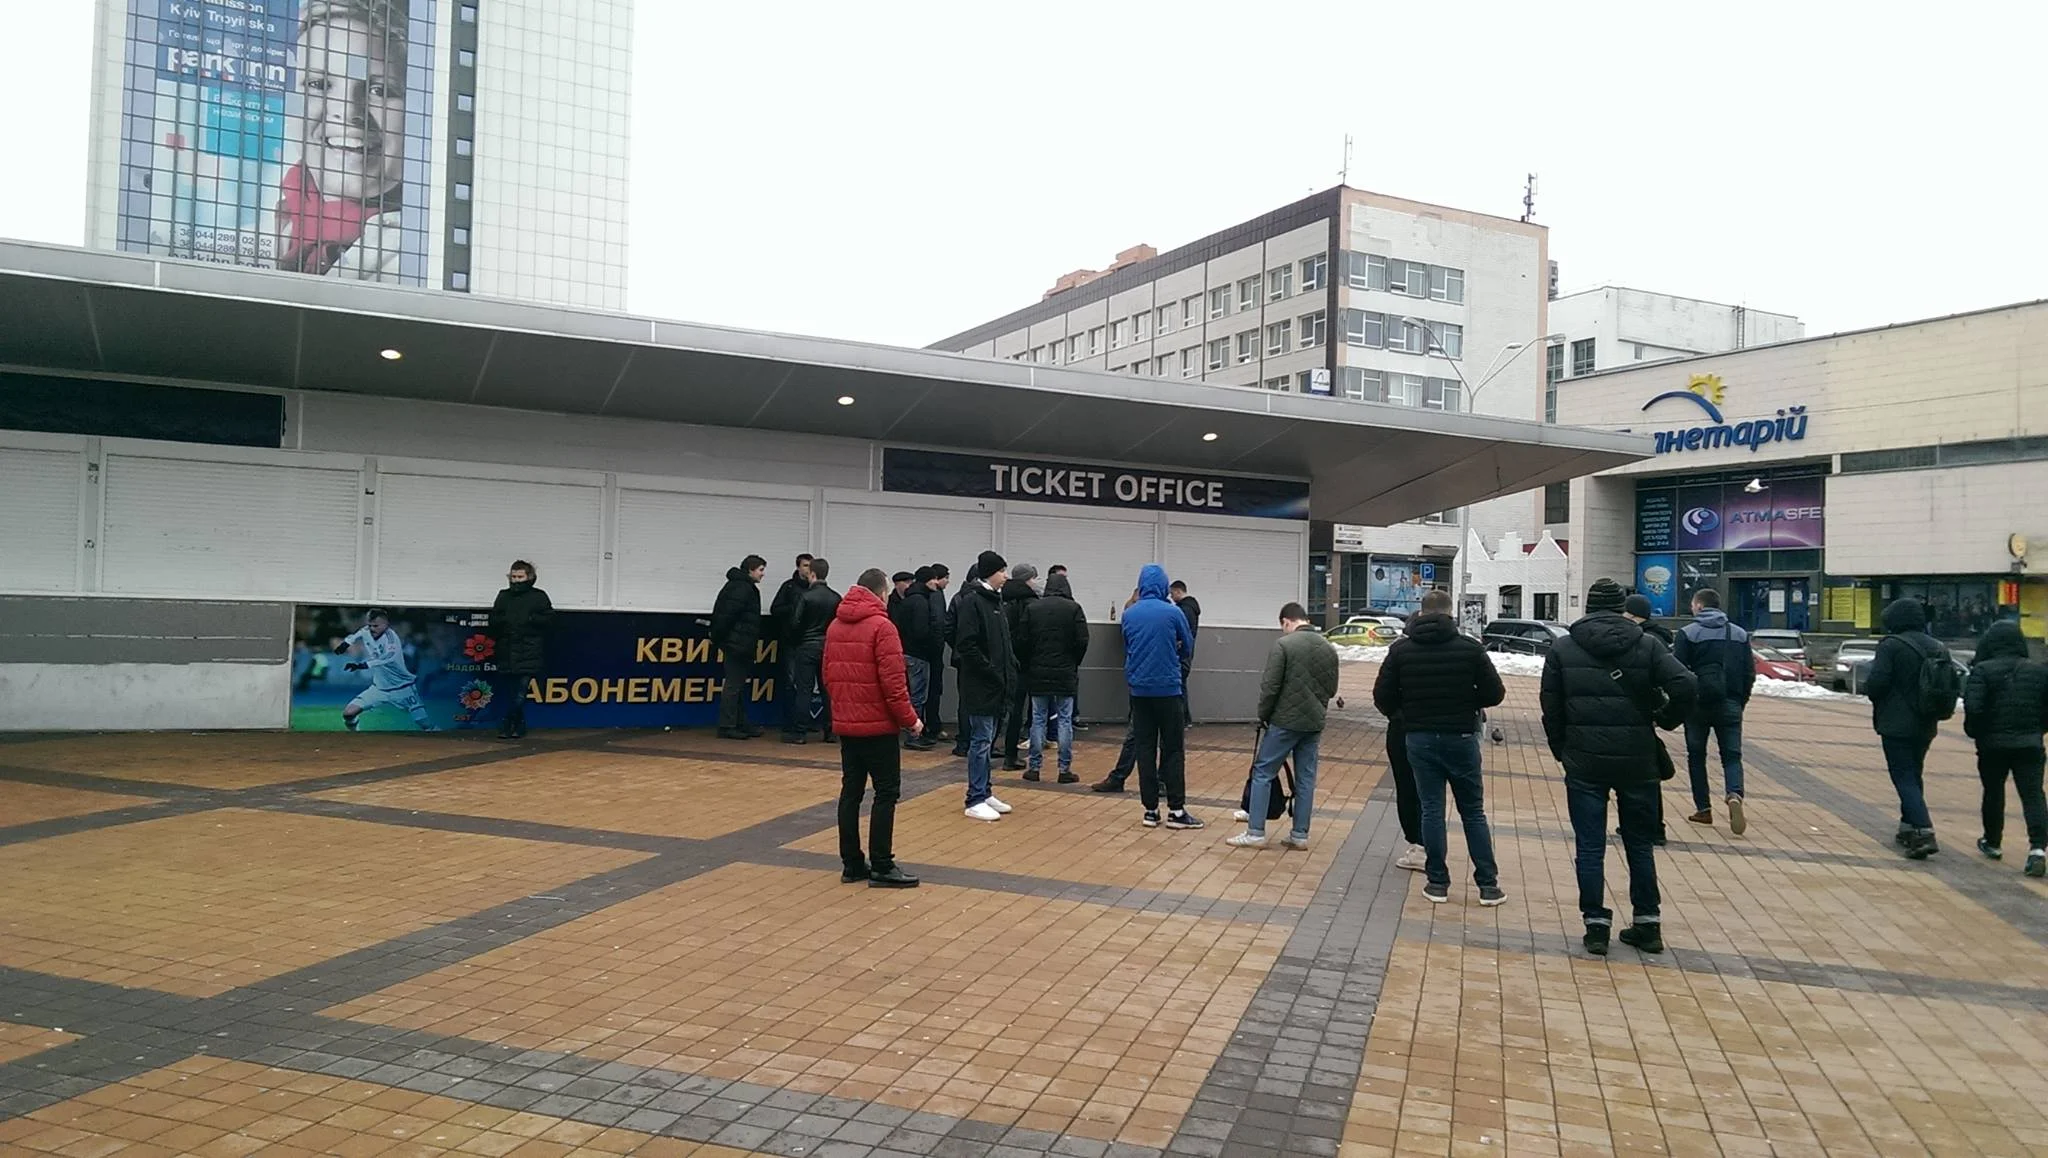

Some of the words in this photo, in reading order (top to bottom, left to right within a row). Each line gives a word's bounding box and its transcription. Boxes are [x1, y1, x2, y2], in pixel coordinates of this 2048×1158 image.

[170, 3, 201, 18] Kyiv
[167, 46, 236, 75] park
[195, 230, 214, 239] 044
[217, 233, 236, 243] 289
[241, 236, 254, 246] 02
[260, 239, 272, 247] 52
[989, 464, 1105, 498] TICKET
[1114, 475, 1224, 508] OFFICE
[1423, 565, 1433, 580] P
[636, 637, 778, 663] КВИИ
[526, 677, 774, 704] АБОНЕМЕНИ
